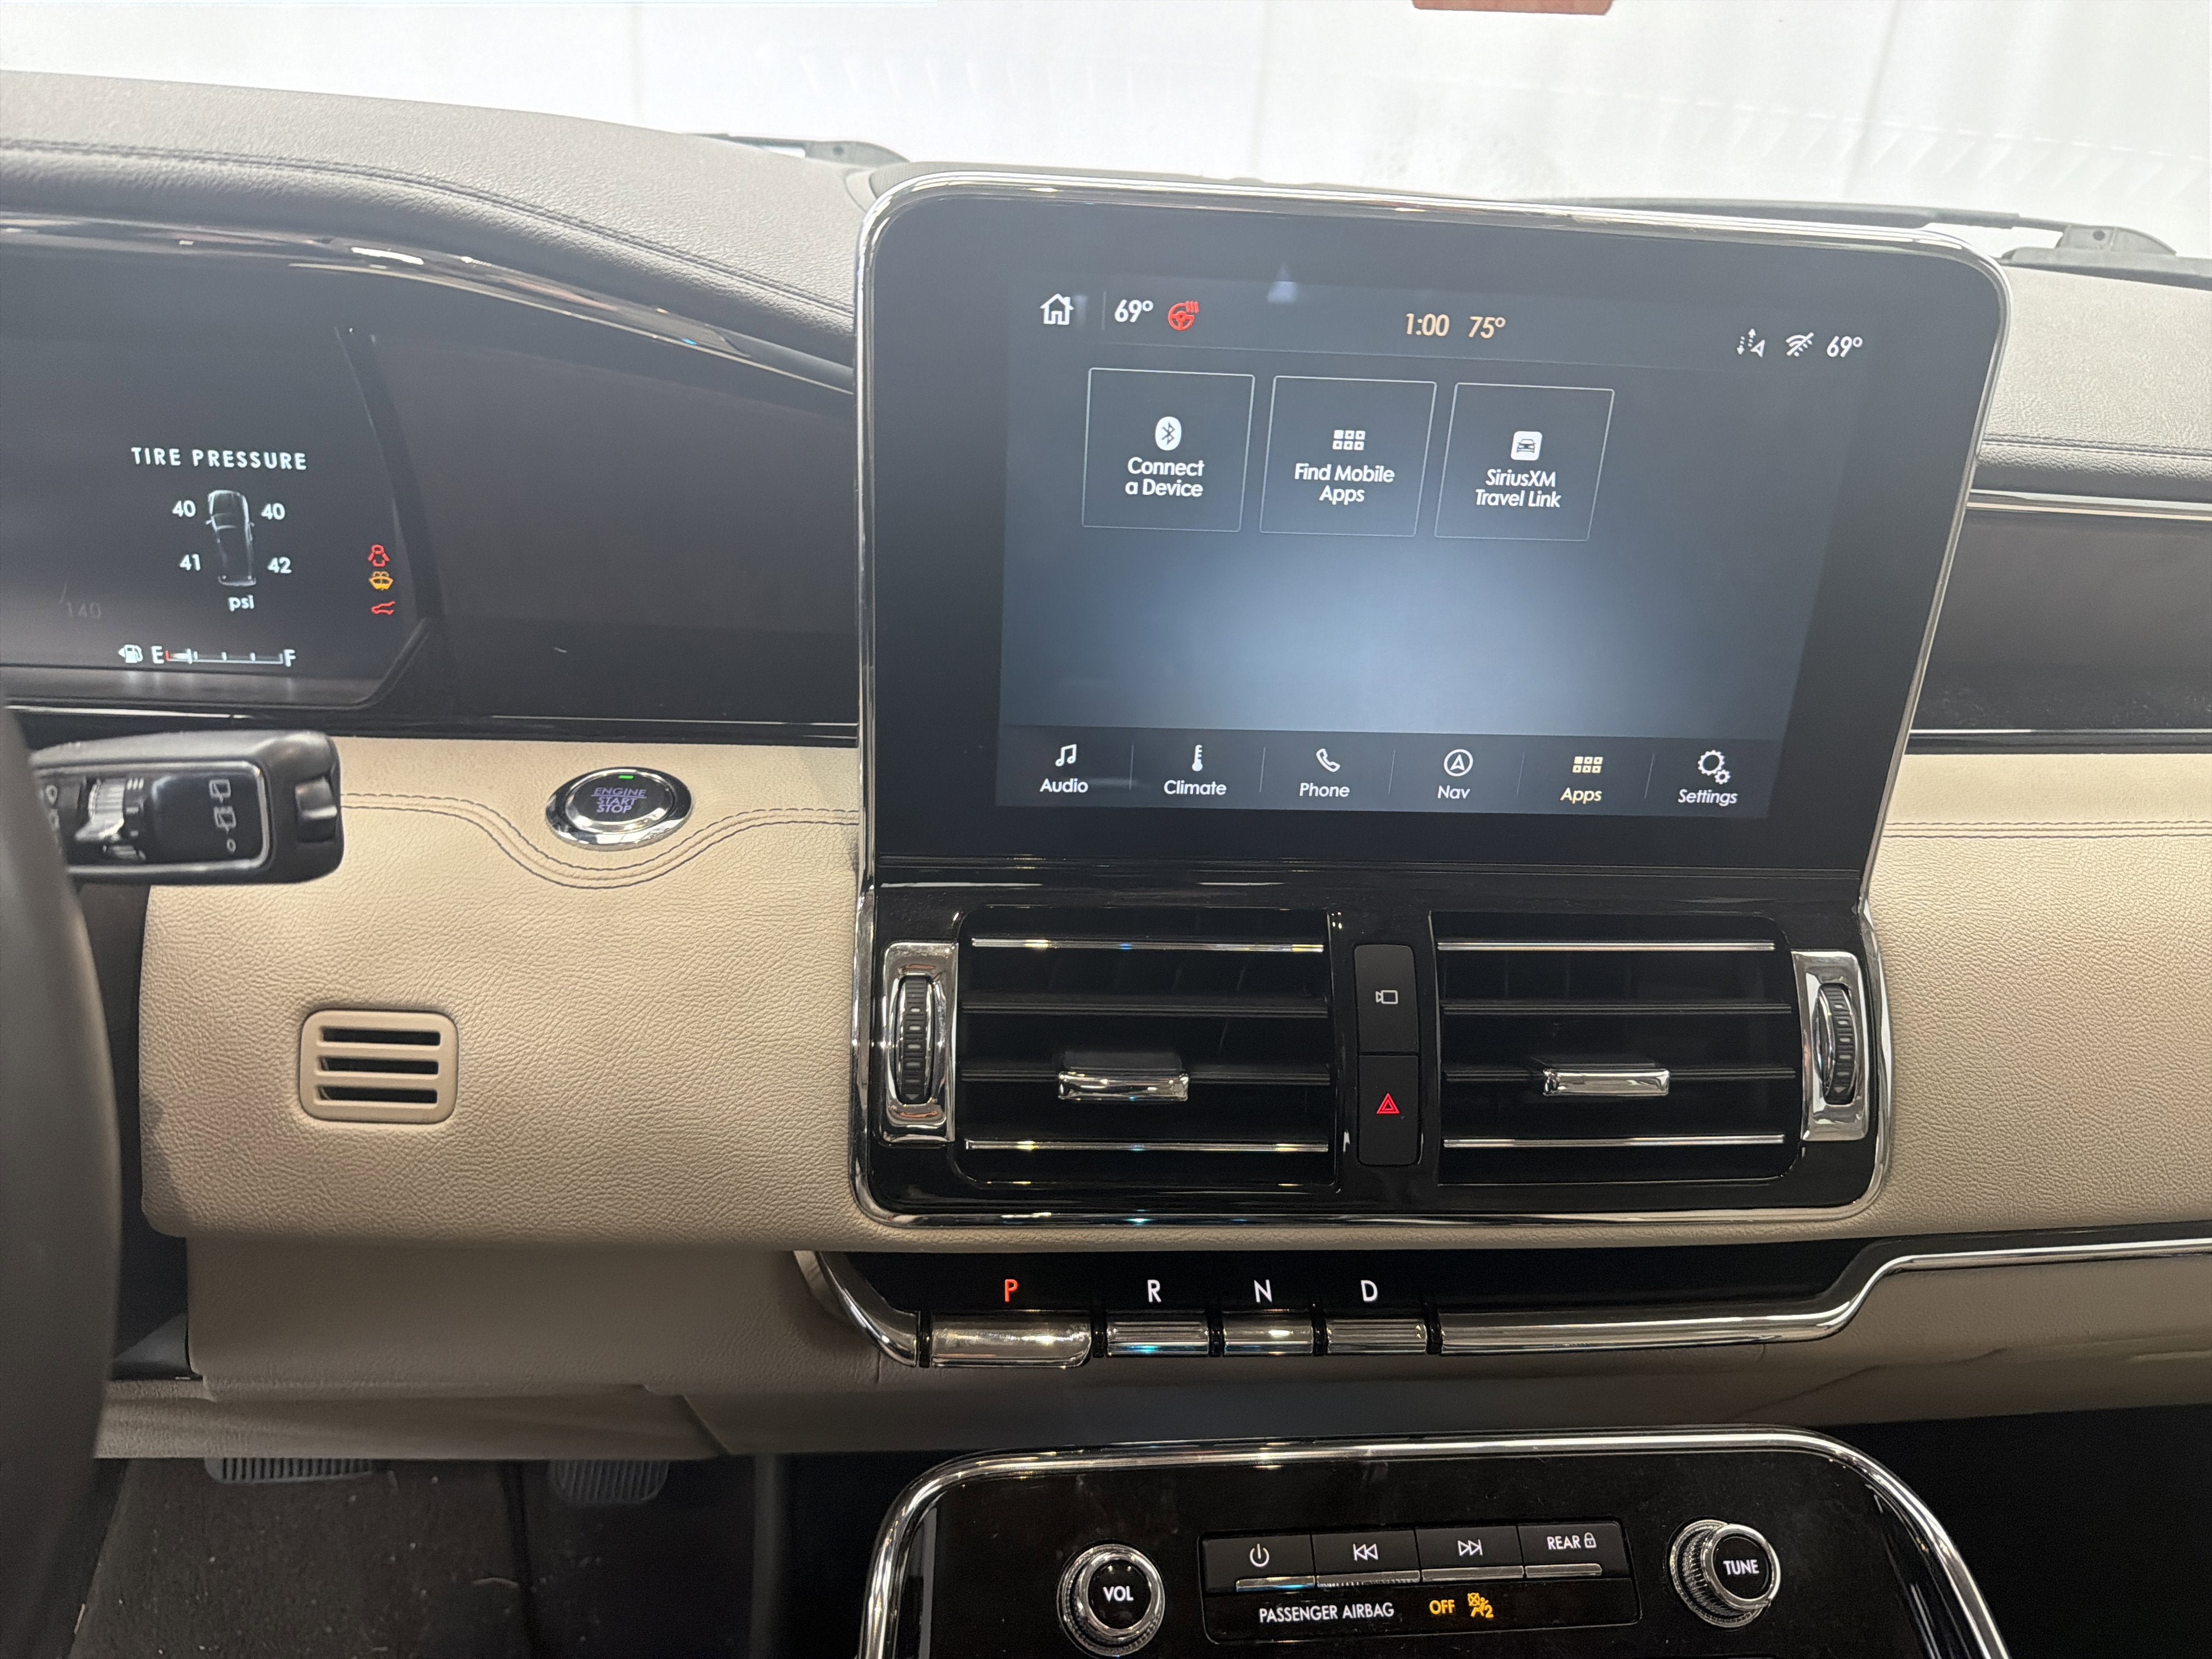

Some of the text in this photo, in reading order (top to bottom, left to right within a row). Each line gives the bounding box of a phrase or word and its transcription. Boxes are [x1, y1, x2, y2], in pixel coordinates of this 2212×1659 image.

[1114, 299, 1154, 323] 69°
[1406, 313, 1506, 338] 1:00 75°
[1826, 335, 1863, 358] 69°
[131, 447, 307, 470] TIRE PRESSURE
[1127, 456, 1205, 477] Connect
[1294, 462, 1395, 483] Find Mobile
[1485, 469, 1556, 488] SiriusXM
[1125, 478, 1204, 498] a Device
[1319, 485, 1365, 505] Apps
[1475, 489, 1562, 508] Travel Link
[172, 500, 196, 517] 40
[261, 503, 285, 520] 40
[179, 554, 201, 571] 41
[267, 557, 292, 574] 42
[228, 595, 255, 612] psi
[151, 646, 164, 664] E
[285, 649, 296, 667] F
[594, 787, 647, 796] ENGINE
[1039, 778, 1088, 793] Audio
[1164, 780, 1227, 795] Climate
[1299, 782, 1350, 798] Phone
[1437, 785, 1471, 799] Nav
[597, 797, 636, 805] START
[1560, 787, 1602, 804] Apps
[1678, 788, 1738, 806] Settings
[597, 805, 632, 814] STOP
[1005, 1279, 1019, 1303] P
[1147, 1279, 1161, 1302] R
[1254, 1279, 1272, 1303] N
[1361, 1280, 1378, 1302] D
[1547, 1535, 1582, 1550] REAR
[1723, 1559, 1759, 1575] TUNE
[1103, 1585, 1134, 1602] VOL
[1259, 1599, 1455, 1623] PASSENGER AIRBAG OFF
